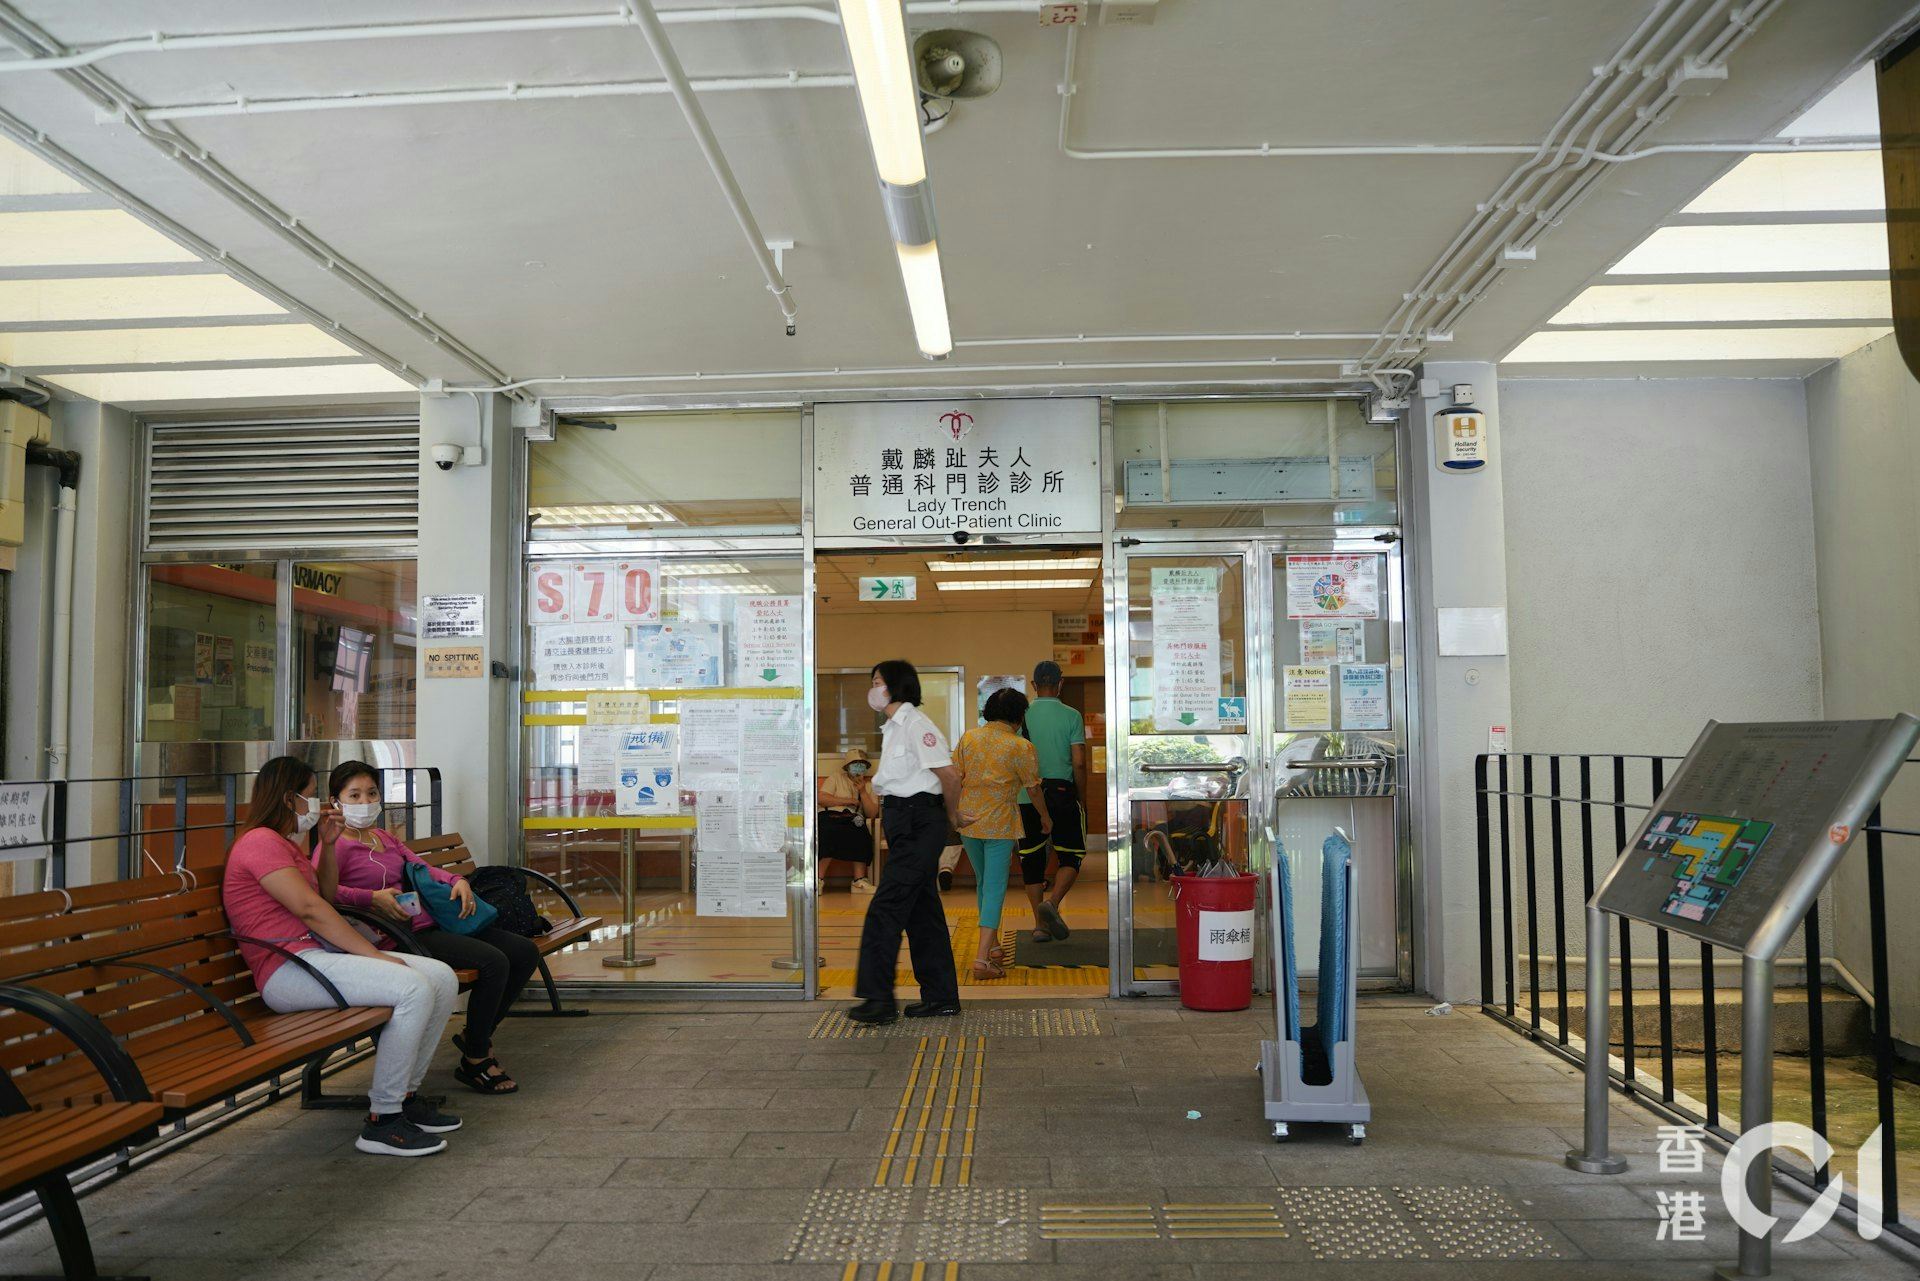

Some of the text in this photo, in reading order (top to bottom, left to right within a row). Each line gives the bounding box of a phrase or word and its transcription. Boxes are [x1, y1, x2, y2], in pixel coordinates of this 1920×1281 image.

[882, 447, 1032, 471] 戴麟趾夫人
[849, 470, 1065, 496] 普通科門診診所
[907, 497, 1007, 515] Lady Trench
[853, 512, 1062, 531] General Out-Patient Clinic
[272, 565, 341, 594] ARMACY
[206, 604, 214, 623] 7
[258, 615, 265, 632] 6
[429, 653, 479, 662] NO SPITTING
[1210, 928, 1250, 945] 雨傘桶
